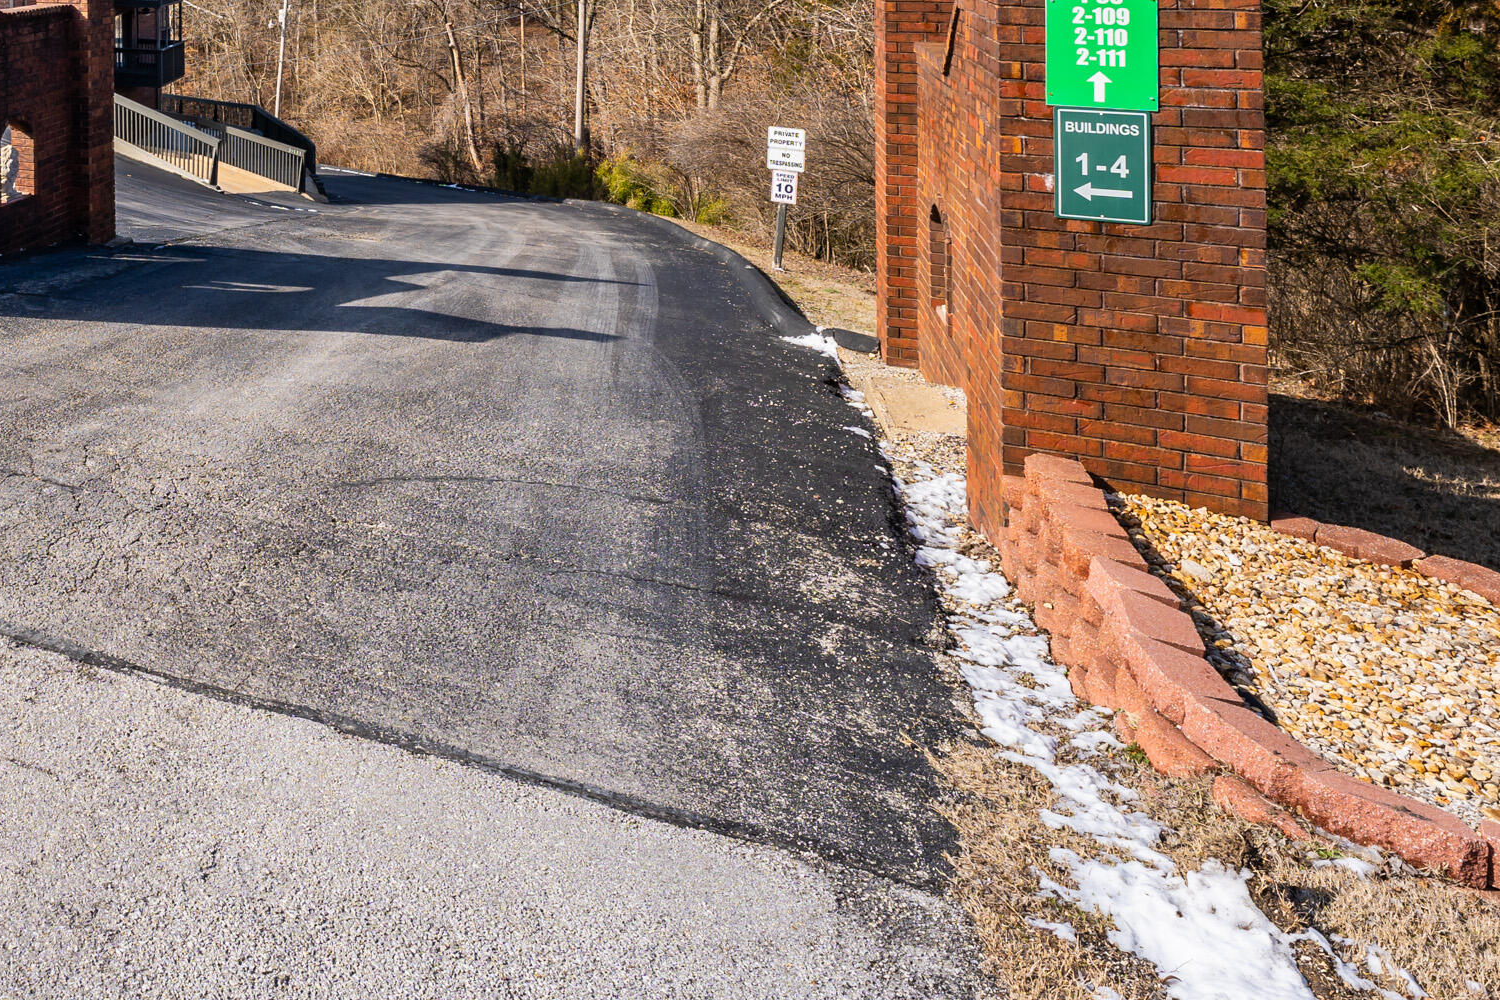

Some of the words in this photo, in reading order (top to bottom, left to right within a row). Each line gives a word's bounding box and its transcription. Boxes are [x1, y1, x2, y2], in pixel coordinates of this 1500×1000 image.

[1071, 5, 1130, 26] 2-109
[1074, 26, 1128, 47] 2-110
[1075, 47, 1127, 68] 2-111
[773, 130, 800, 138] PRIVATE
[1064, 121, 1140, 136] BUILDINGS
[769, 138, 803, 147] PROPERTY
[769, 159, 803, 169] TRESPASSING
[776, 183, 794, 194] 10
